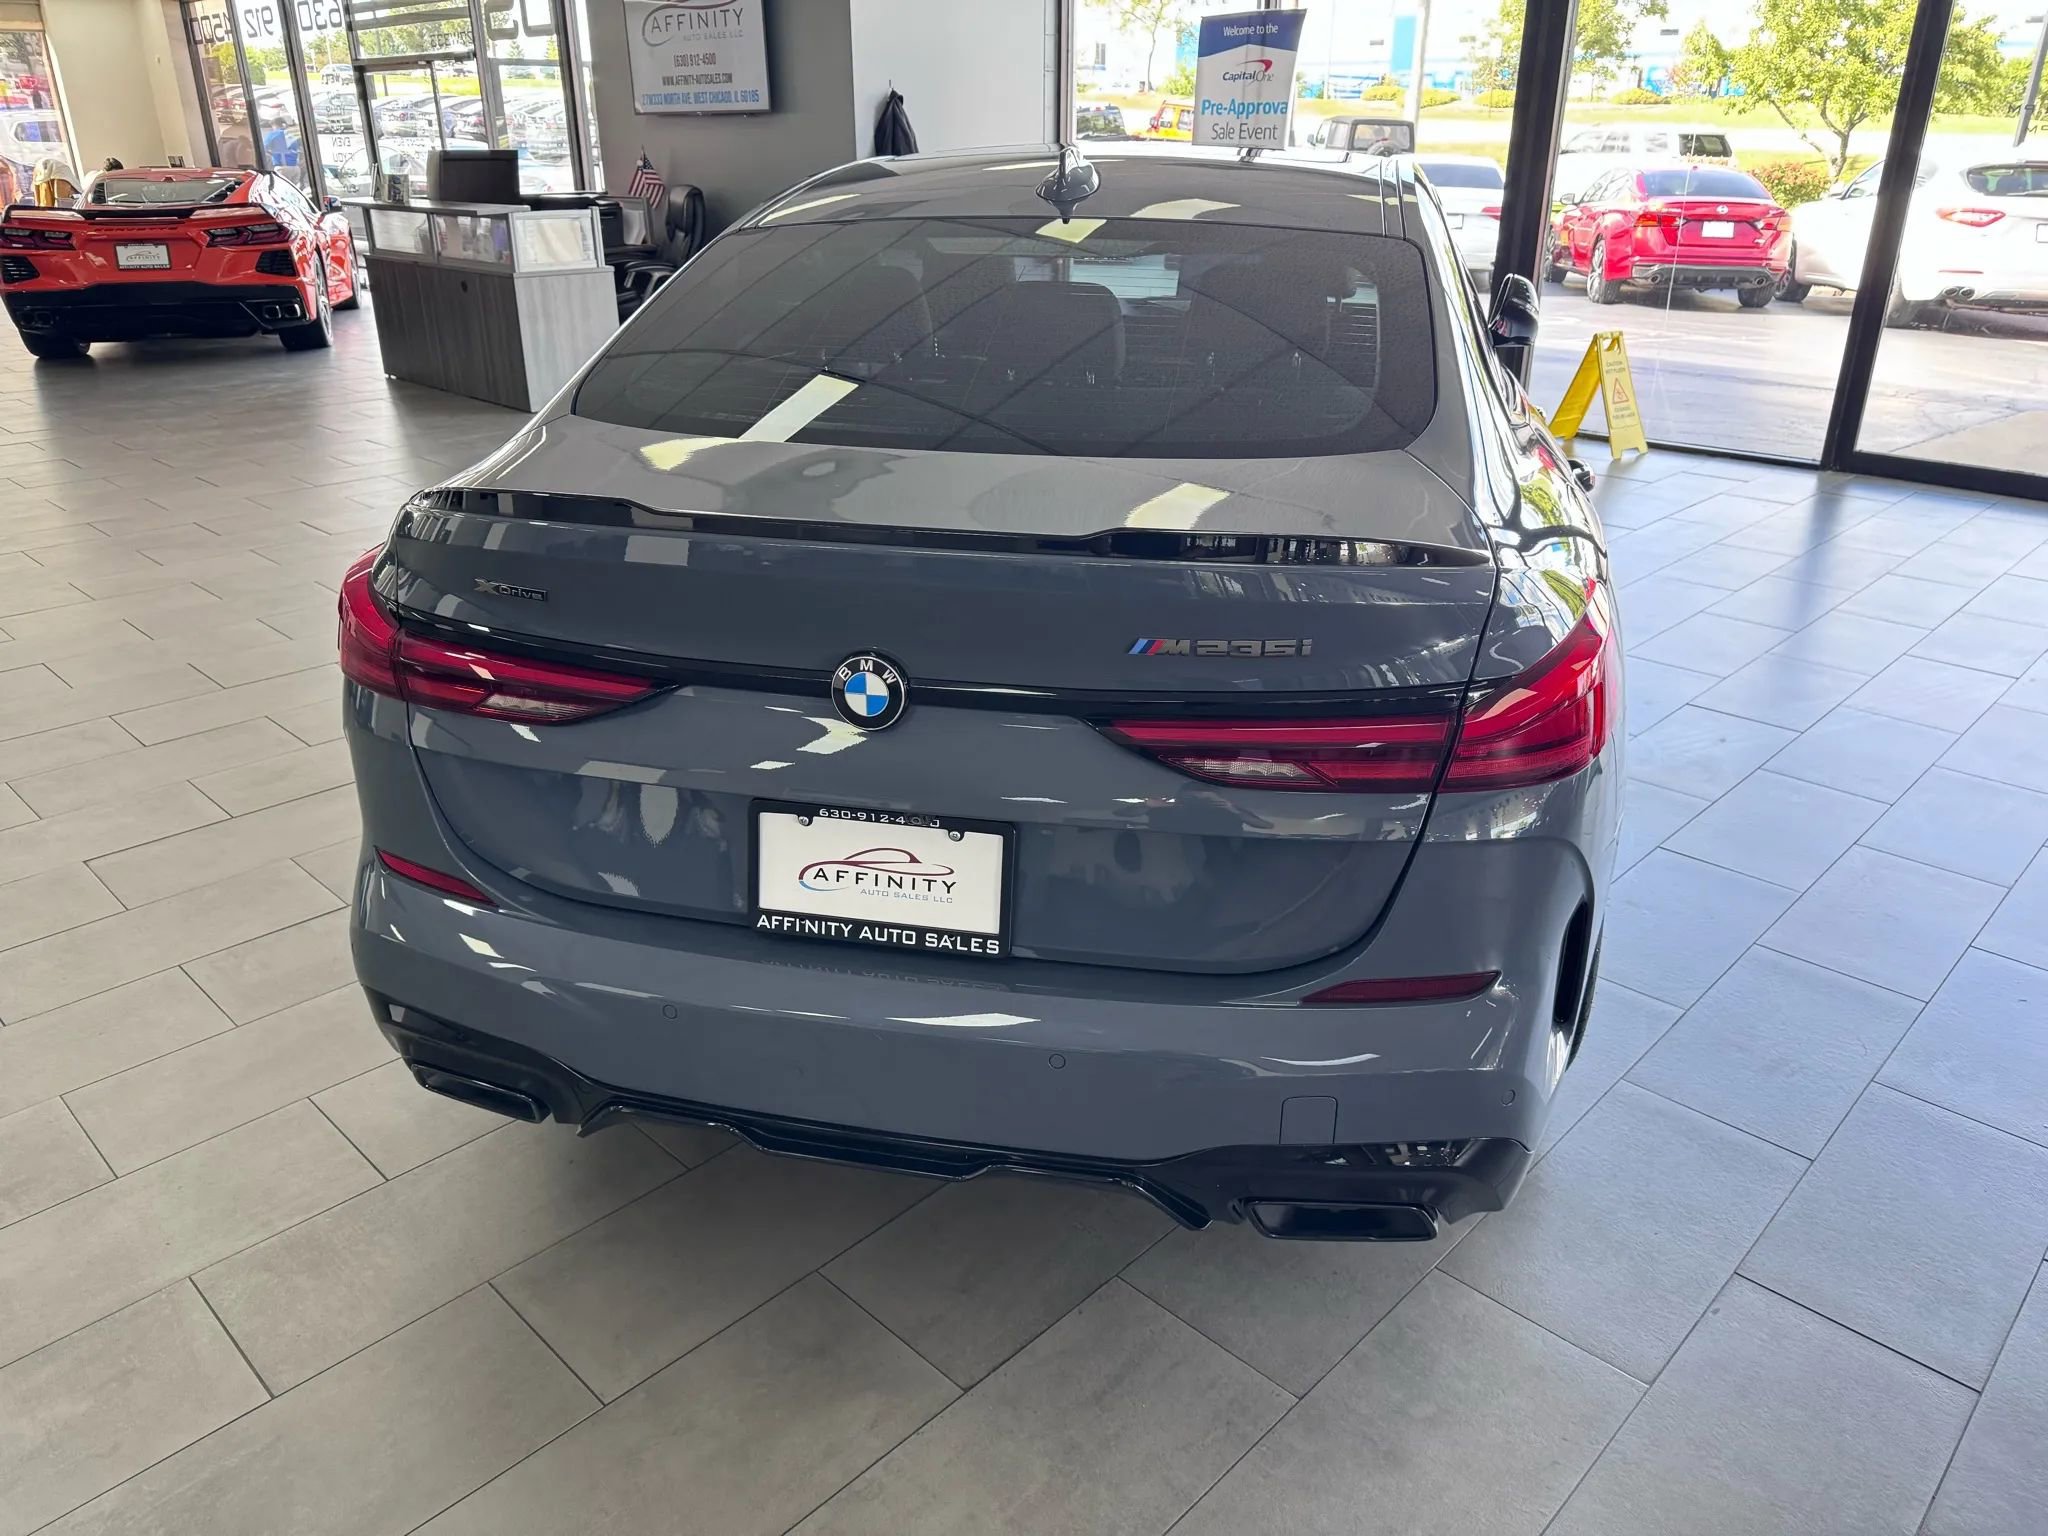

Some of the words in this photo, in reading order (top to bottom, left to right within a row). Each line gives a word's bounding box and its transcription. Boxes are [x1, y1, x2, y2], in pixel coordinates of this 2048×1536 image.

[651, 7, 744, 33] AFFINITY
[1223, 26, 1255, 37] Welcome
[1256, 25, 1265, 35] to
[1265, 23, 1279, 34] the
[1201, 98, 1288, 119] Pre-Approva
[1211, 121, 1236, 140] Sale
[1238, 122, 1279, 140] Event
[838, 659, 897, 684] BMW
[819, 808, 940, 827] 630-912-40
[813, 867, 957, 894] AFFINITY
[860, 888, 889, 897] AUTO
[894, 891, 929, 901] SALES
[933, 895, 953, 904] LLC
[756, 914, 852, 938] AFFINITY
[859, 925, 916, 945] AUTO
[925, 932, 999, 955] SALES
